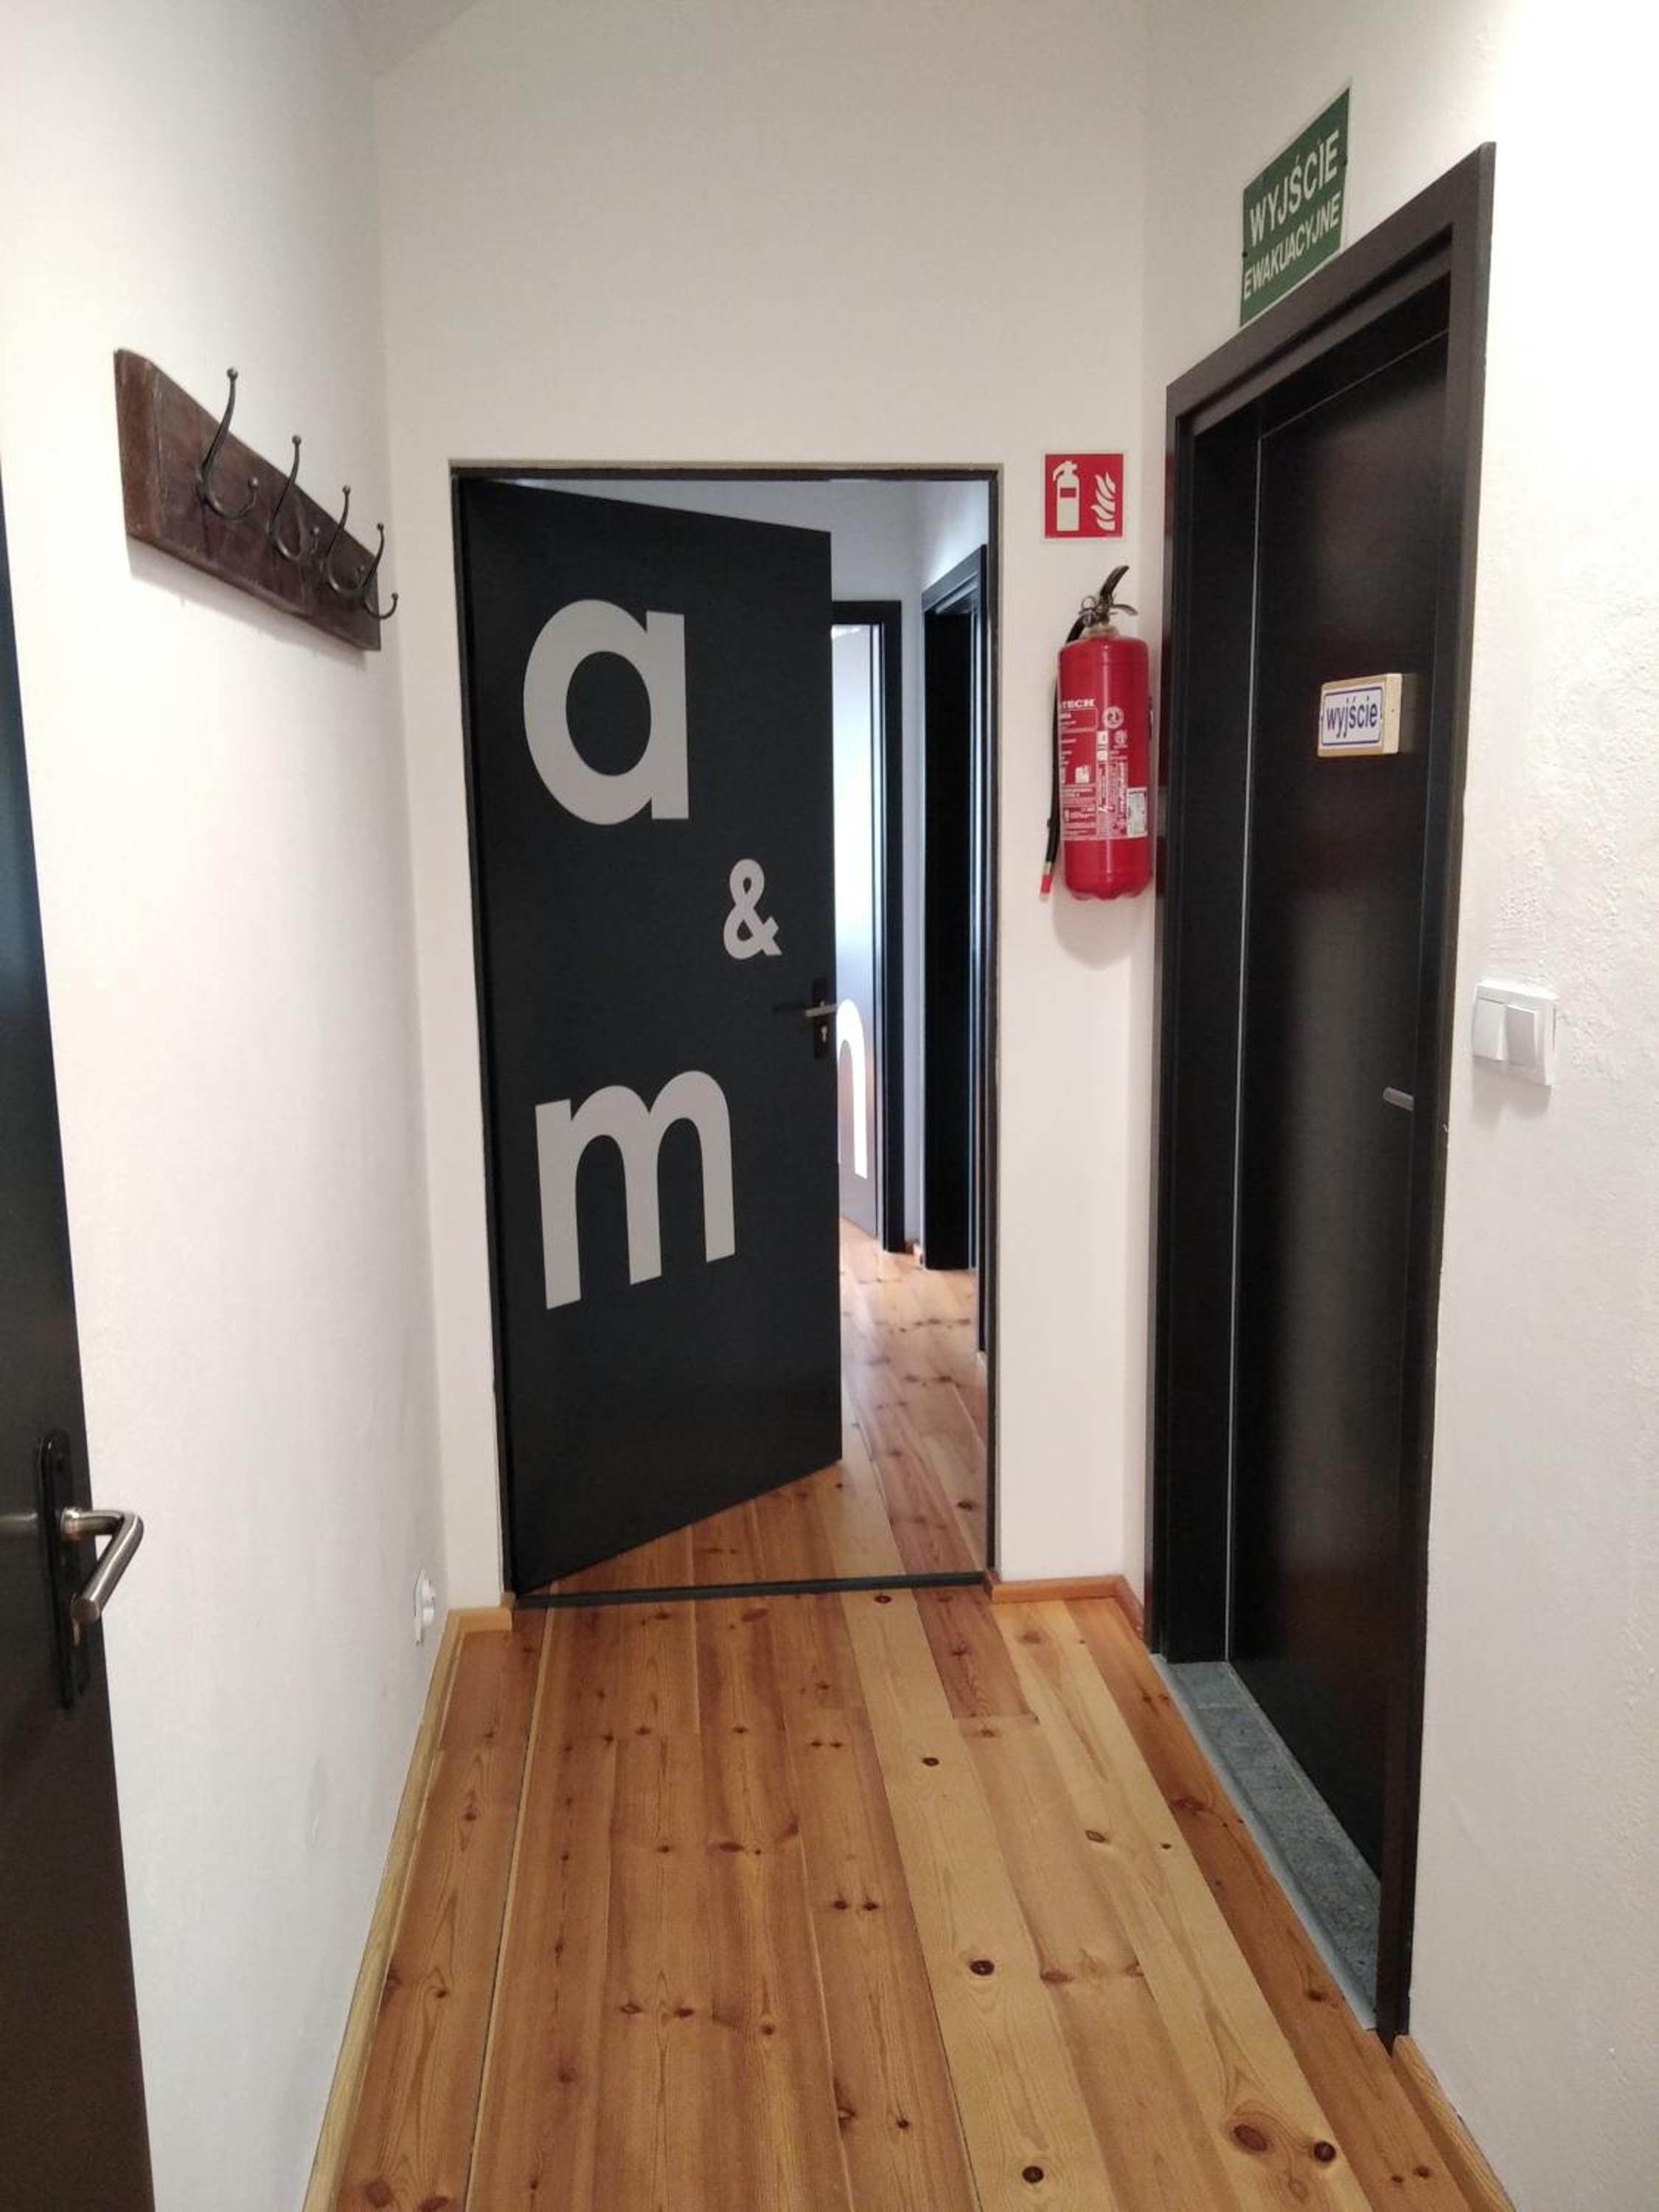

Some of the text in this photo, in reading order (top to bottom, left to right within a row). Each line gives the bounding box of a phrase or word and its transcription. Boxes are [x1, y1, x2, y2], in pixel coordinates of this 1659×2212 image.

[1250, 129, 1340, 248] WYJŚCIE
[1243, 191, 1341, 301] EWAKUACYJNE
[523, 599, 689, 826] a
[1326, 695, 1378, 739] wyjście
[723, 858, 783, 960] &
[535, 1070, 737, 1310] m
